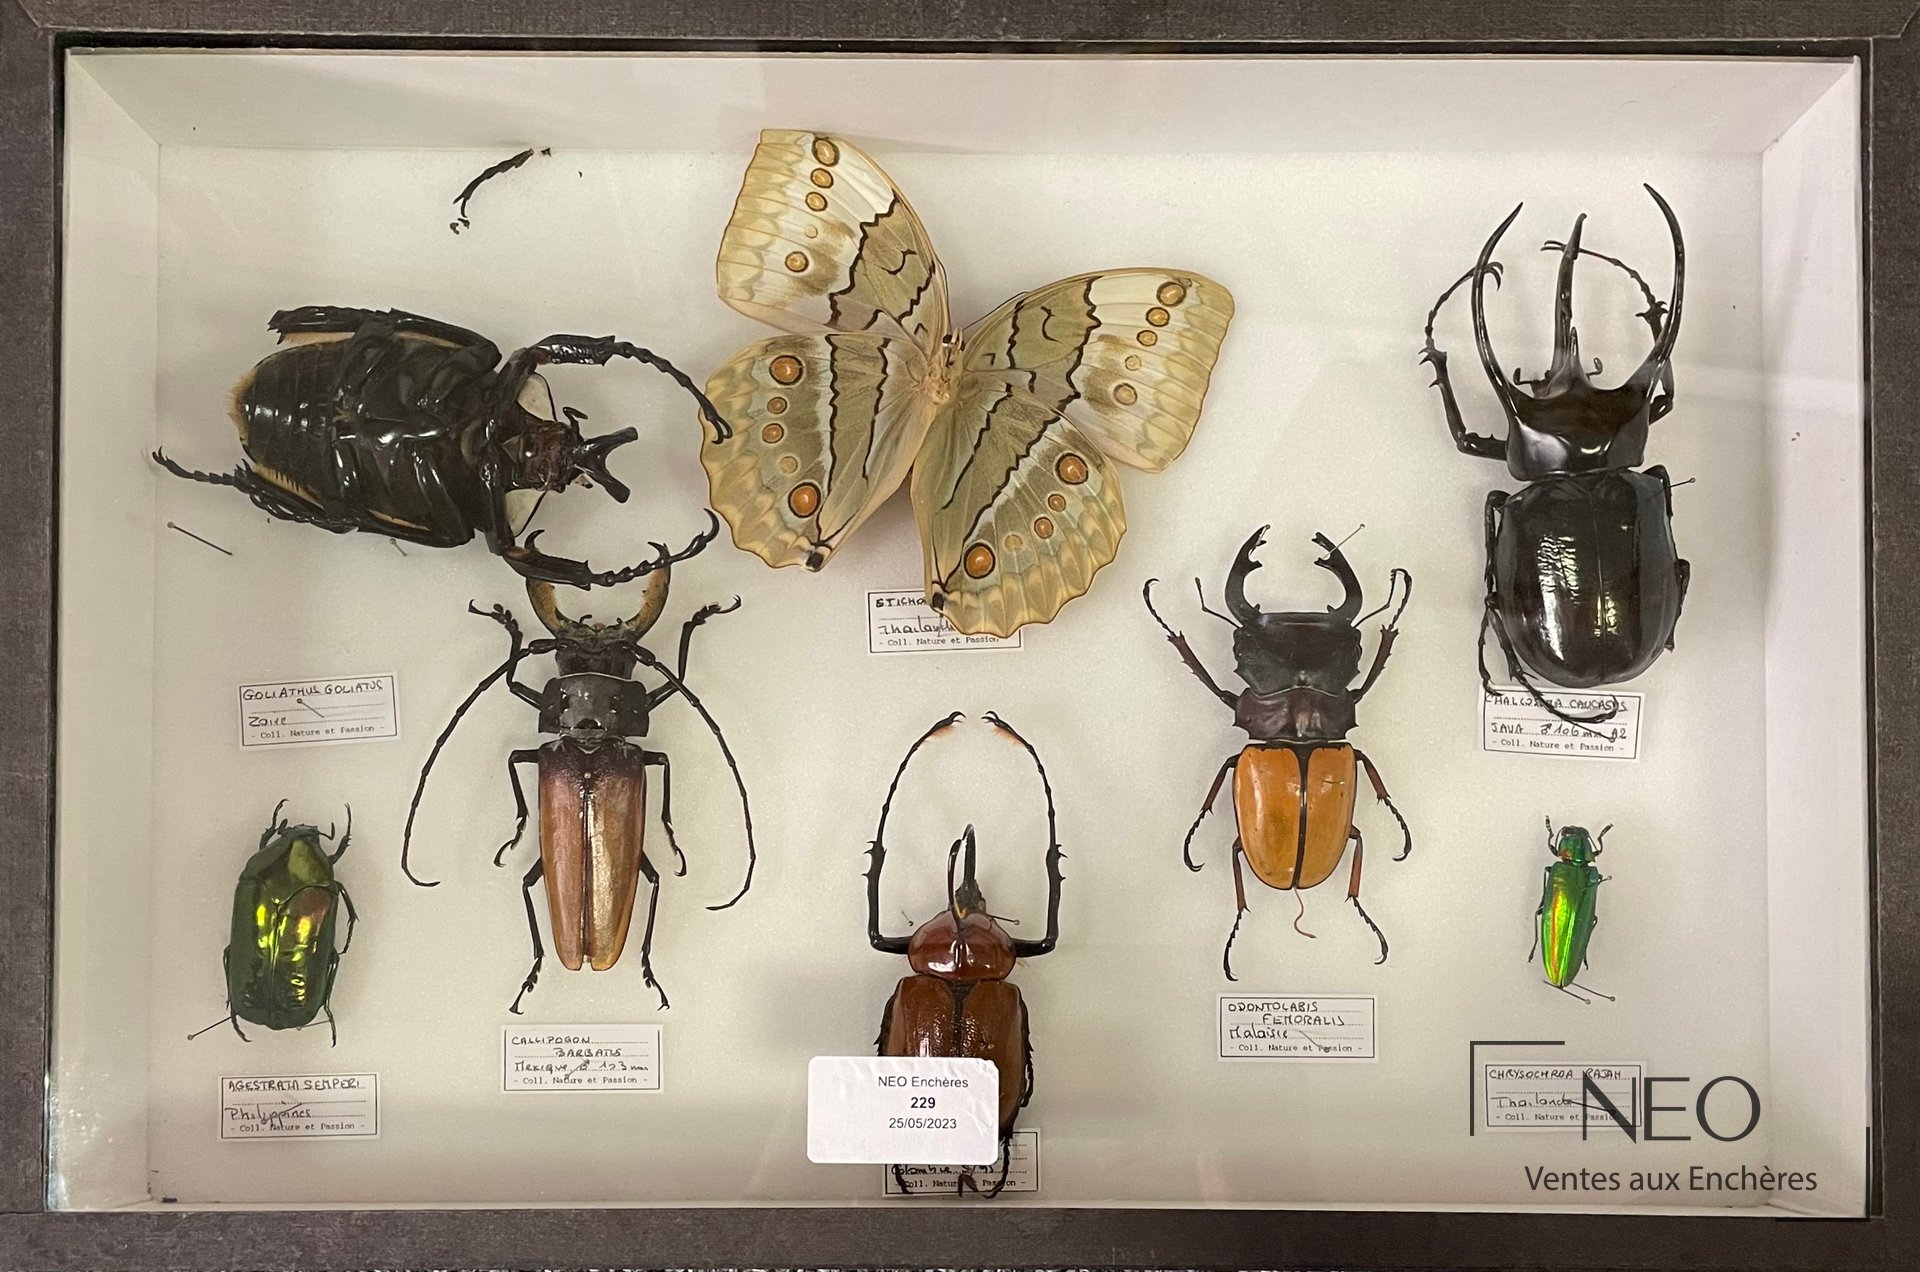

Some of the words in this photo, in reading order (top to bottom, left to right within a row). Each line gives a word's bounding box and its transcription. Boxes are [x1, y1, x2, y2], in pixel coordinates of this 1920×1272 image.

[888, 638, 912, 646] Coll.
[917, 637, 946, 645] Nature
[243, 686, 321, 700] GOLIATHUS
[324, 680, 383, 695] GOLIATUS
[1491, 722, 1523, 734] JAVA
[260, 731, 285, 739] Coll.
[290, 729, 320, 737] Nature
[1501, 739, 1525, 747] Coll.
[1530, 741, 1559, 749] Nature
[1580, 743, 1614, 752] Passion
[1228, 1002, 1318, 1012] ODONTOLABIS
[1262, 1013, 1345, 1026] FEMORALIS
[1238, 1044, 1263, 1052] Coll.
[603, 1076, 637, 1084] Passion
[878, 1076, 907, 1087] NEO
[911, 1076, 969, 1088] Enchères
[910, 1097, 936, 1109] 229
[1505, 1112, 1530, 1121] Coll.
[1535, 1113, 1565, 1121] Nature
[1570, 1113, 1580, 1121] et
[320, 1122, 355, 1130] Passion
[888, 1117, 957, 1129] 25/05/2023
[932, 1180, 959, 1188] Natur
